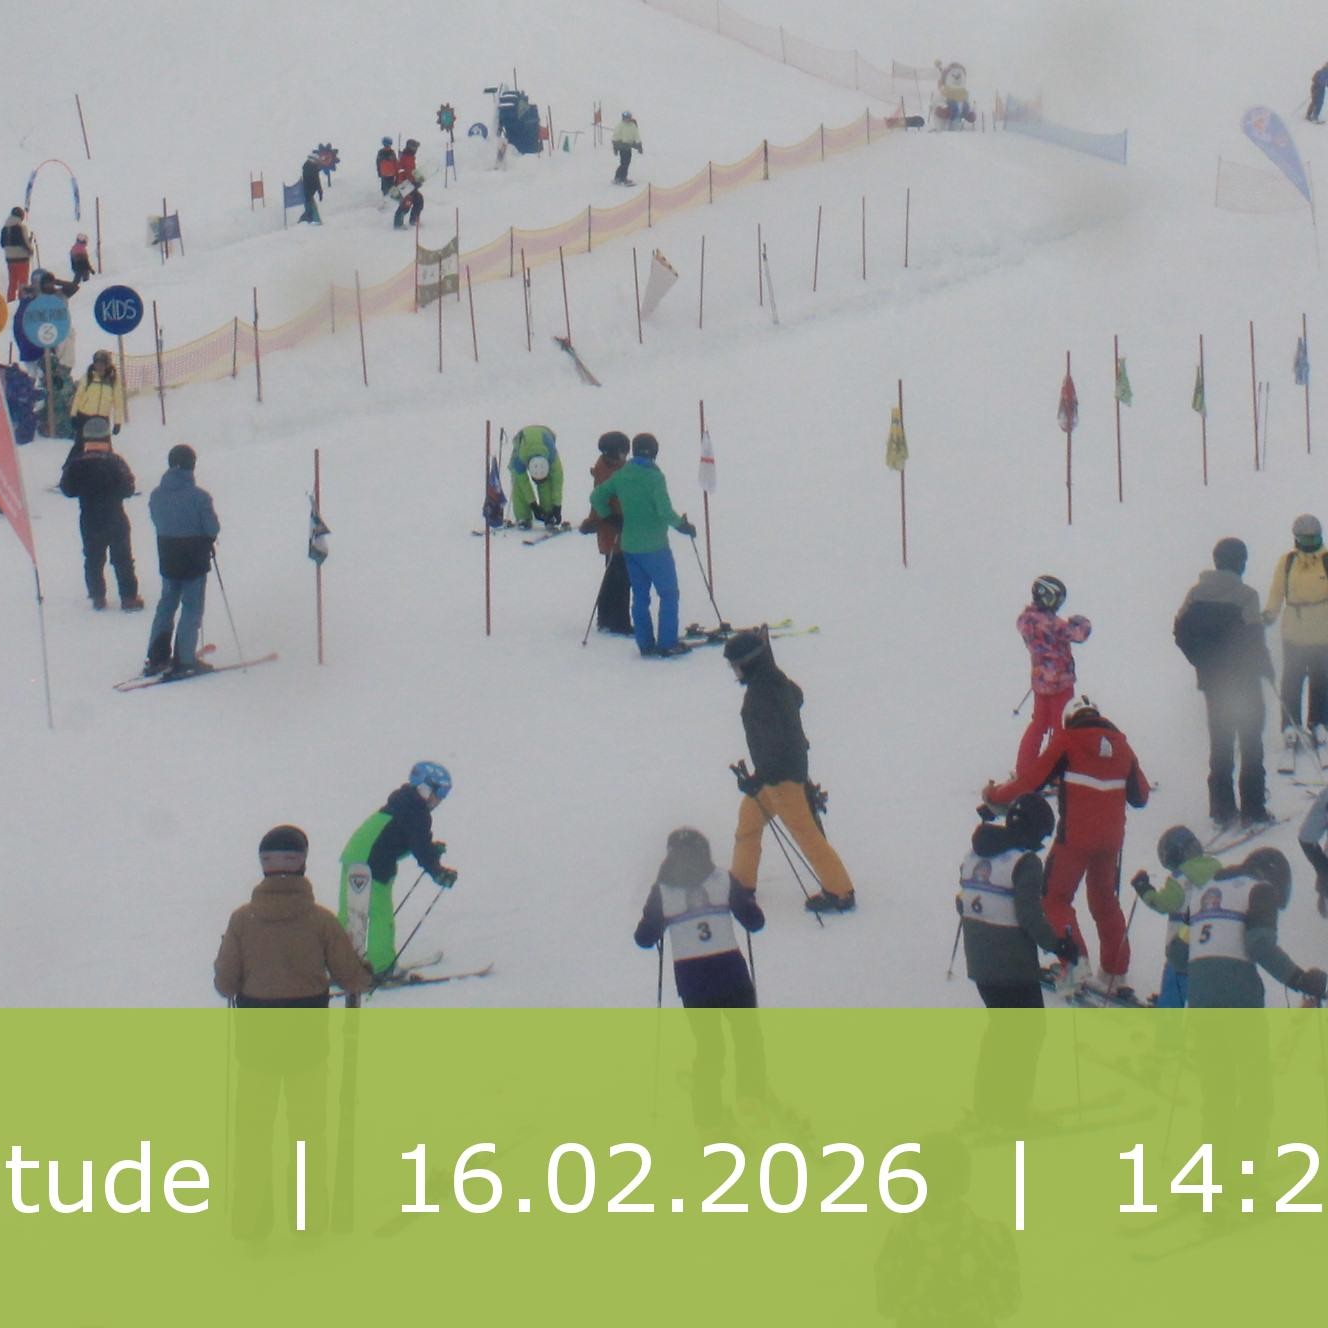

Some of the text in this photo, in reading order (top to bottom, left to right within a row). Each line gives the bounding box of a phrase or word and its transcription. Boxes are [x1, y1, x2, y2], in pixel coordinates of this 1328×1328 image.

[101, 298, 137, 321] KIDS
[971, 894, 983, 914] 6
[697, 921, 712, 942] 3
[1199, 923, 1213, 945] 5
